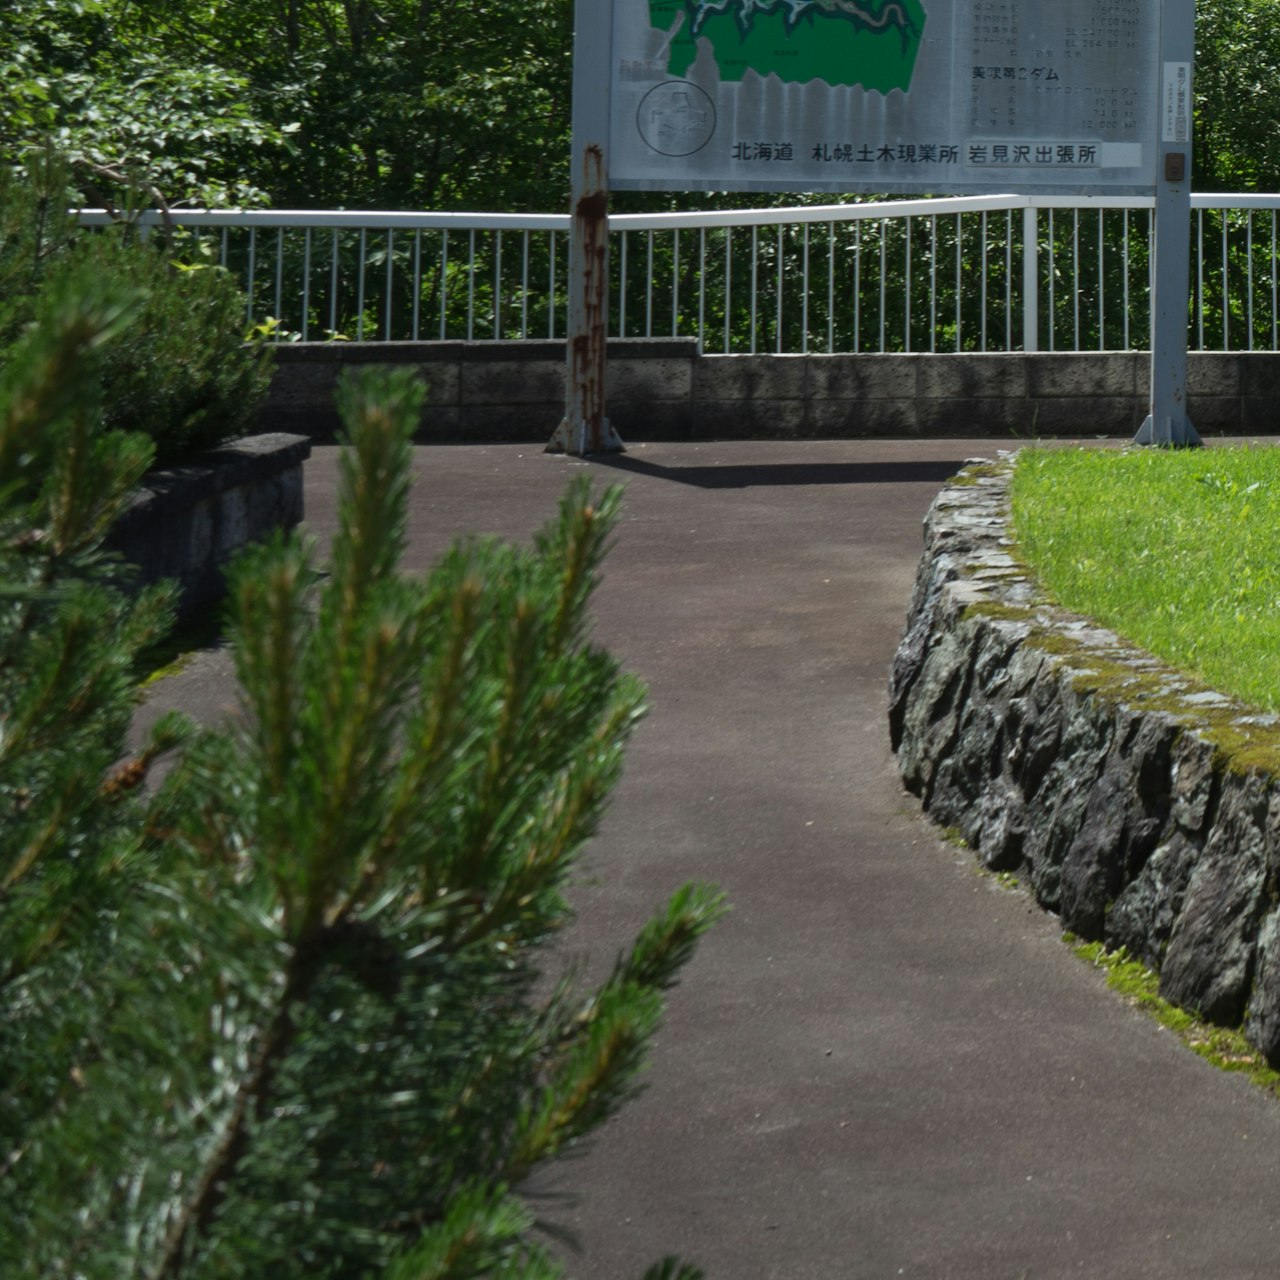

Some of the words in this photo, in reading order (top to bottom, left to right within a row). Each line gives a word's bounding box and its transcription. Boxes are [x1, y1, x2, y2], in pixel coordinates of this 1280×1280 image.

[972, 65, 1059, 81] 美唄第2ダム
[732, 142, 794, 162] 北海道
[811, 142, 959, 164] 札幌土木現業所
[967, 144, 1096, 165] 岩見沢出張所
